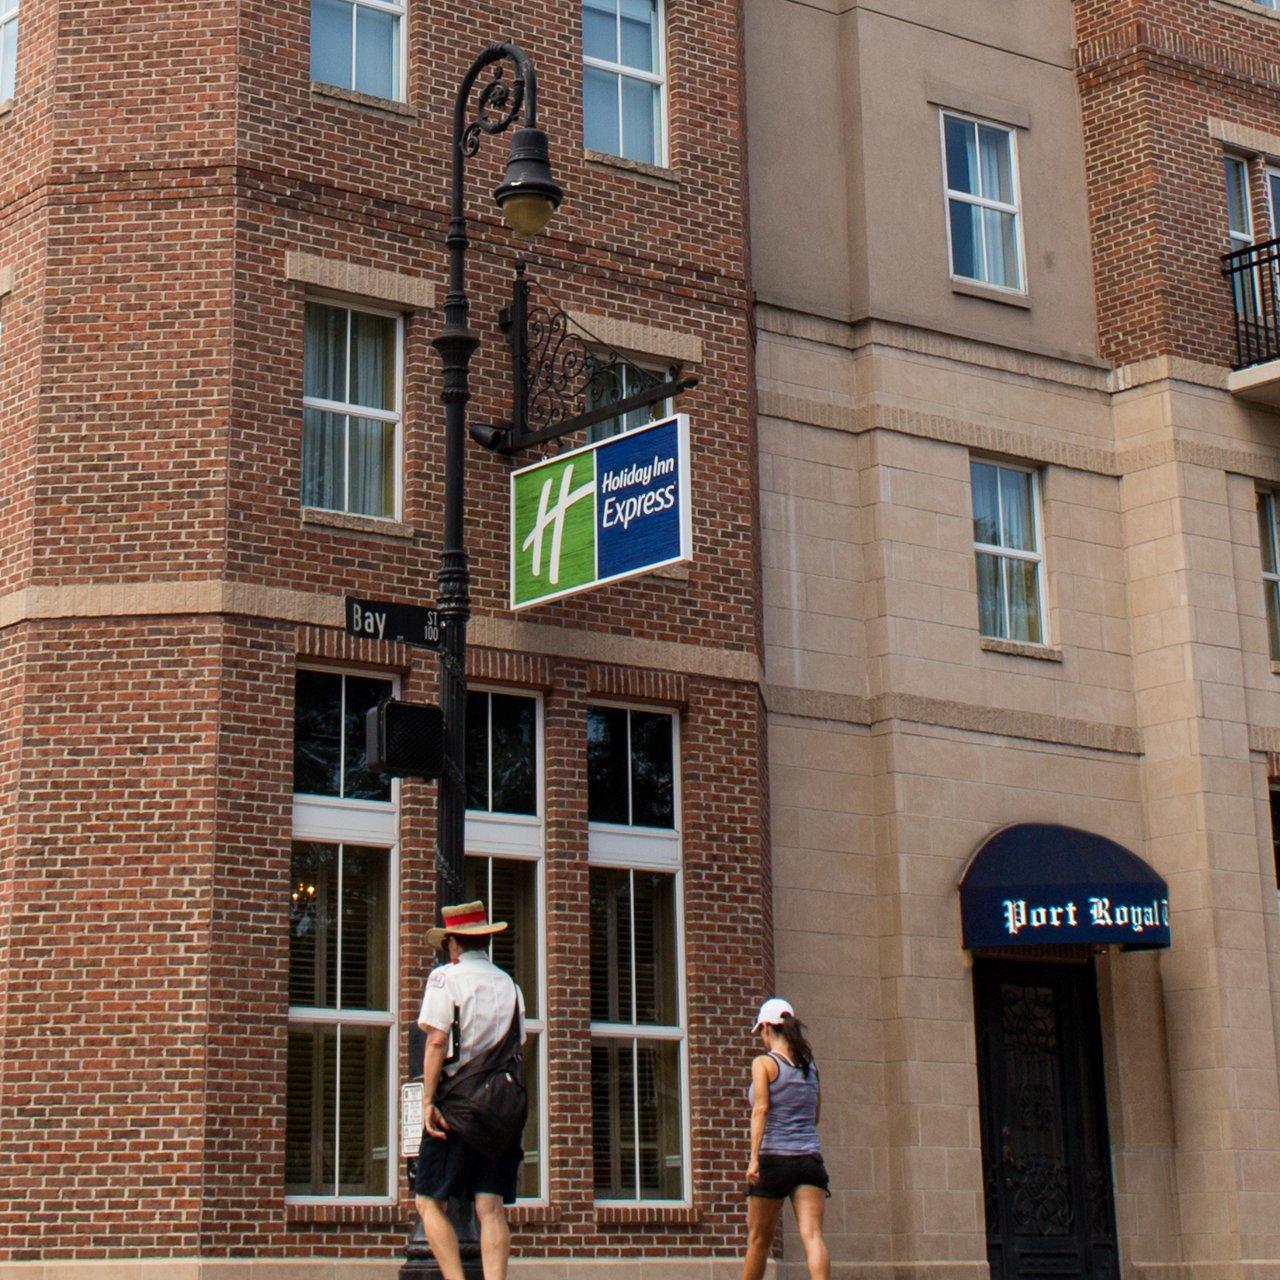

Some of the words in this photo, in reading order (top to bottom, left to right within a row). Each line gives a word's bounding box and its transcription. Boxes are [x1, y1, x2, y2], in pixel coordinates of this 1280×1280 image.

[602, 463, 652, 493] Holiday
[652, 455, 675, 477] Inn
[602, 484, 675, 530] Express
[353, 603, 386, 640] Bay
[427, 611, 438, 626] ST
[424, 625, 439, 640] 100
[1002, 899, 1077, 934] Port
[1088, 897, 1160, 932] Royal
